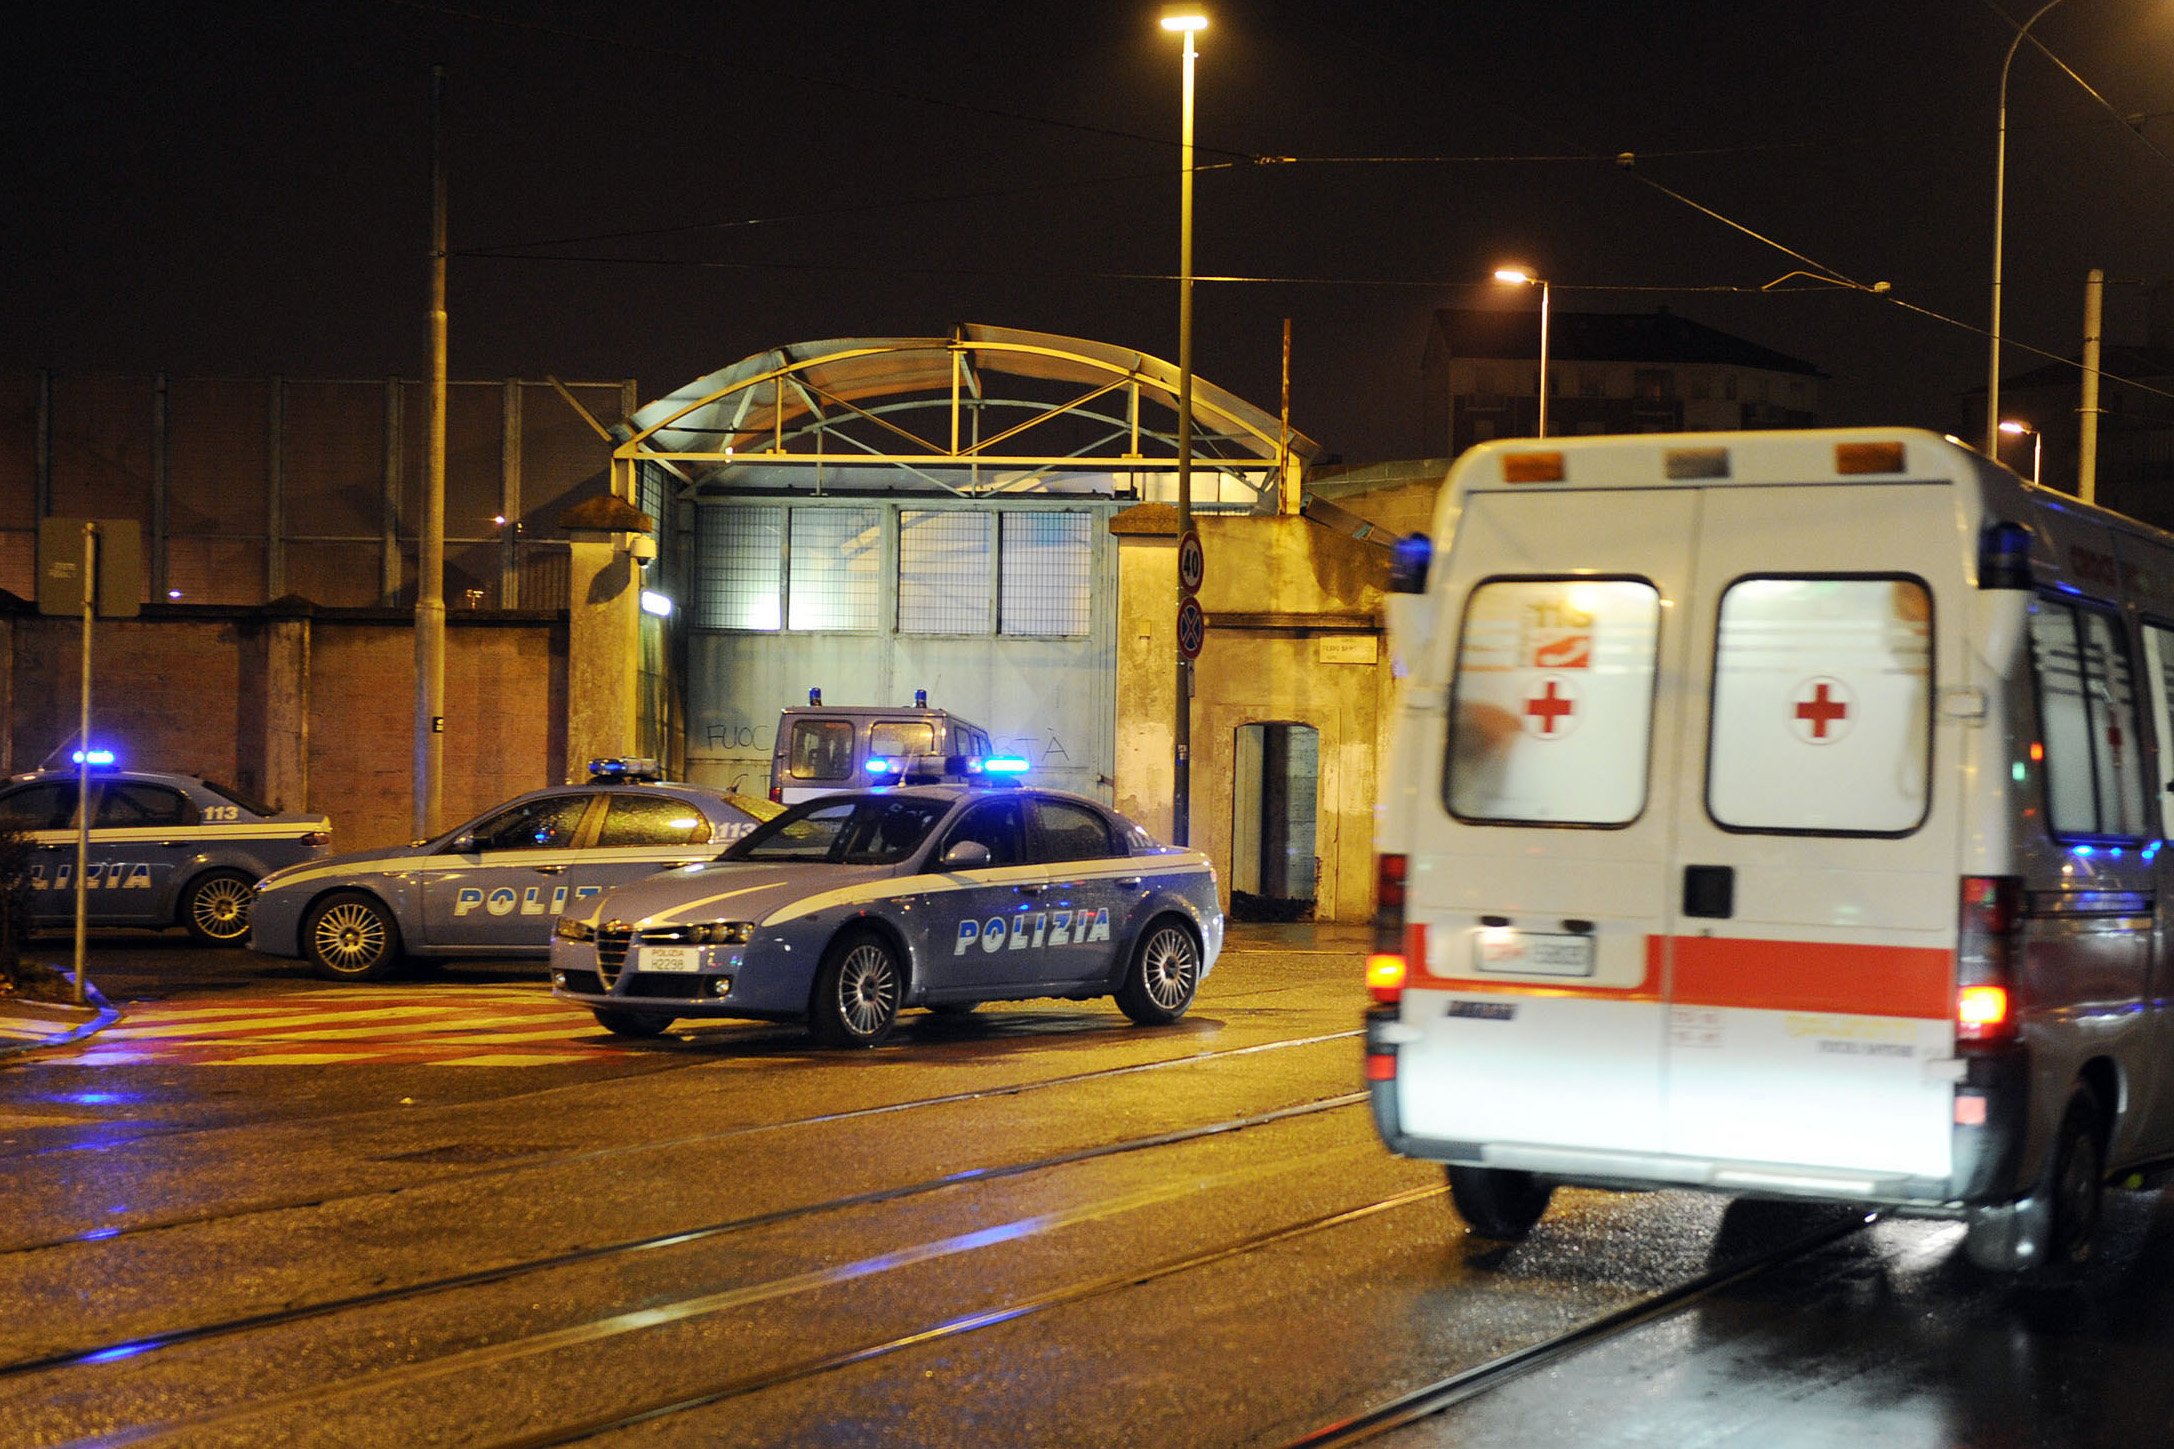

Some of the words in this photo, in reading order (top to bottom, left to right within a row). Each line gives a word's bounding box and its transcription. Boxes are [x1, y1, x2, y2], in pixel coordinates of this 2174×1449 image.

[1184, 549, 1199, 578] 40
[204, 806, 239, 820] 113
[953, 907, 1110, 956] POLIZIA
